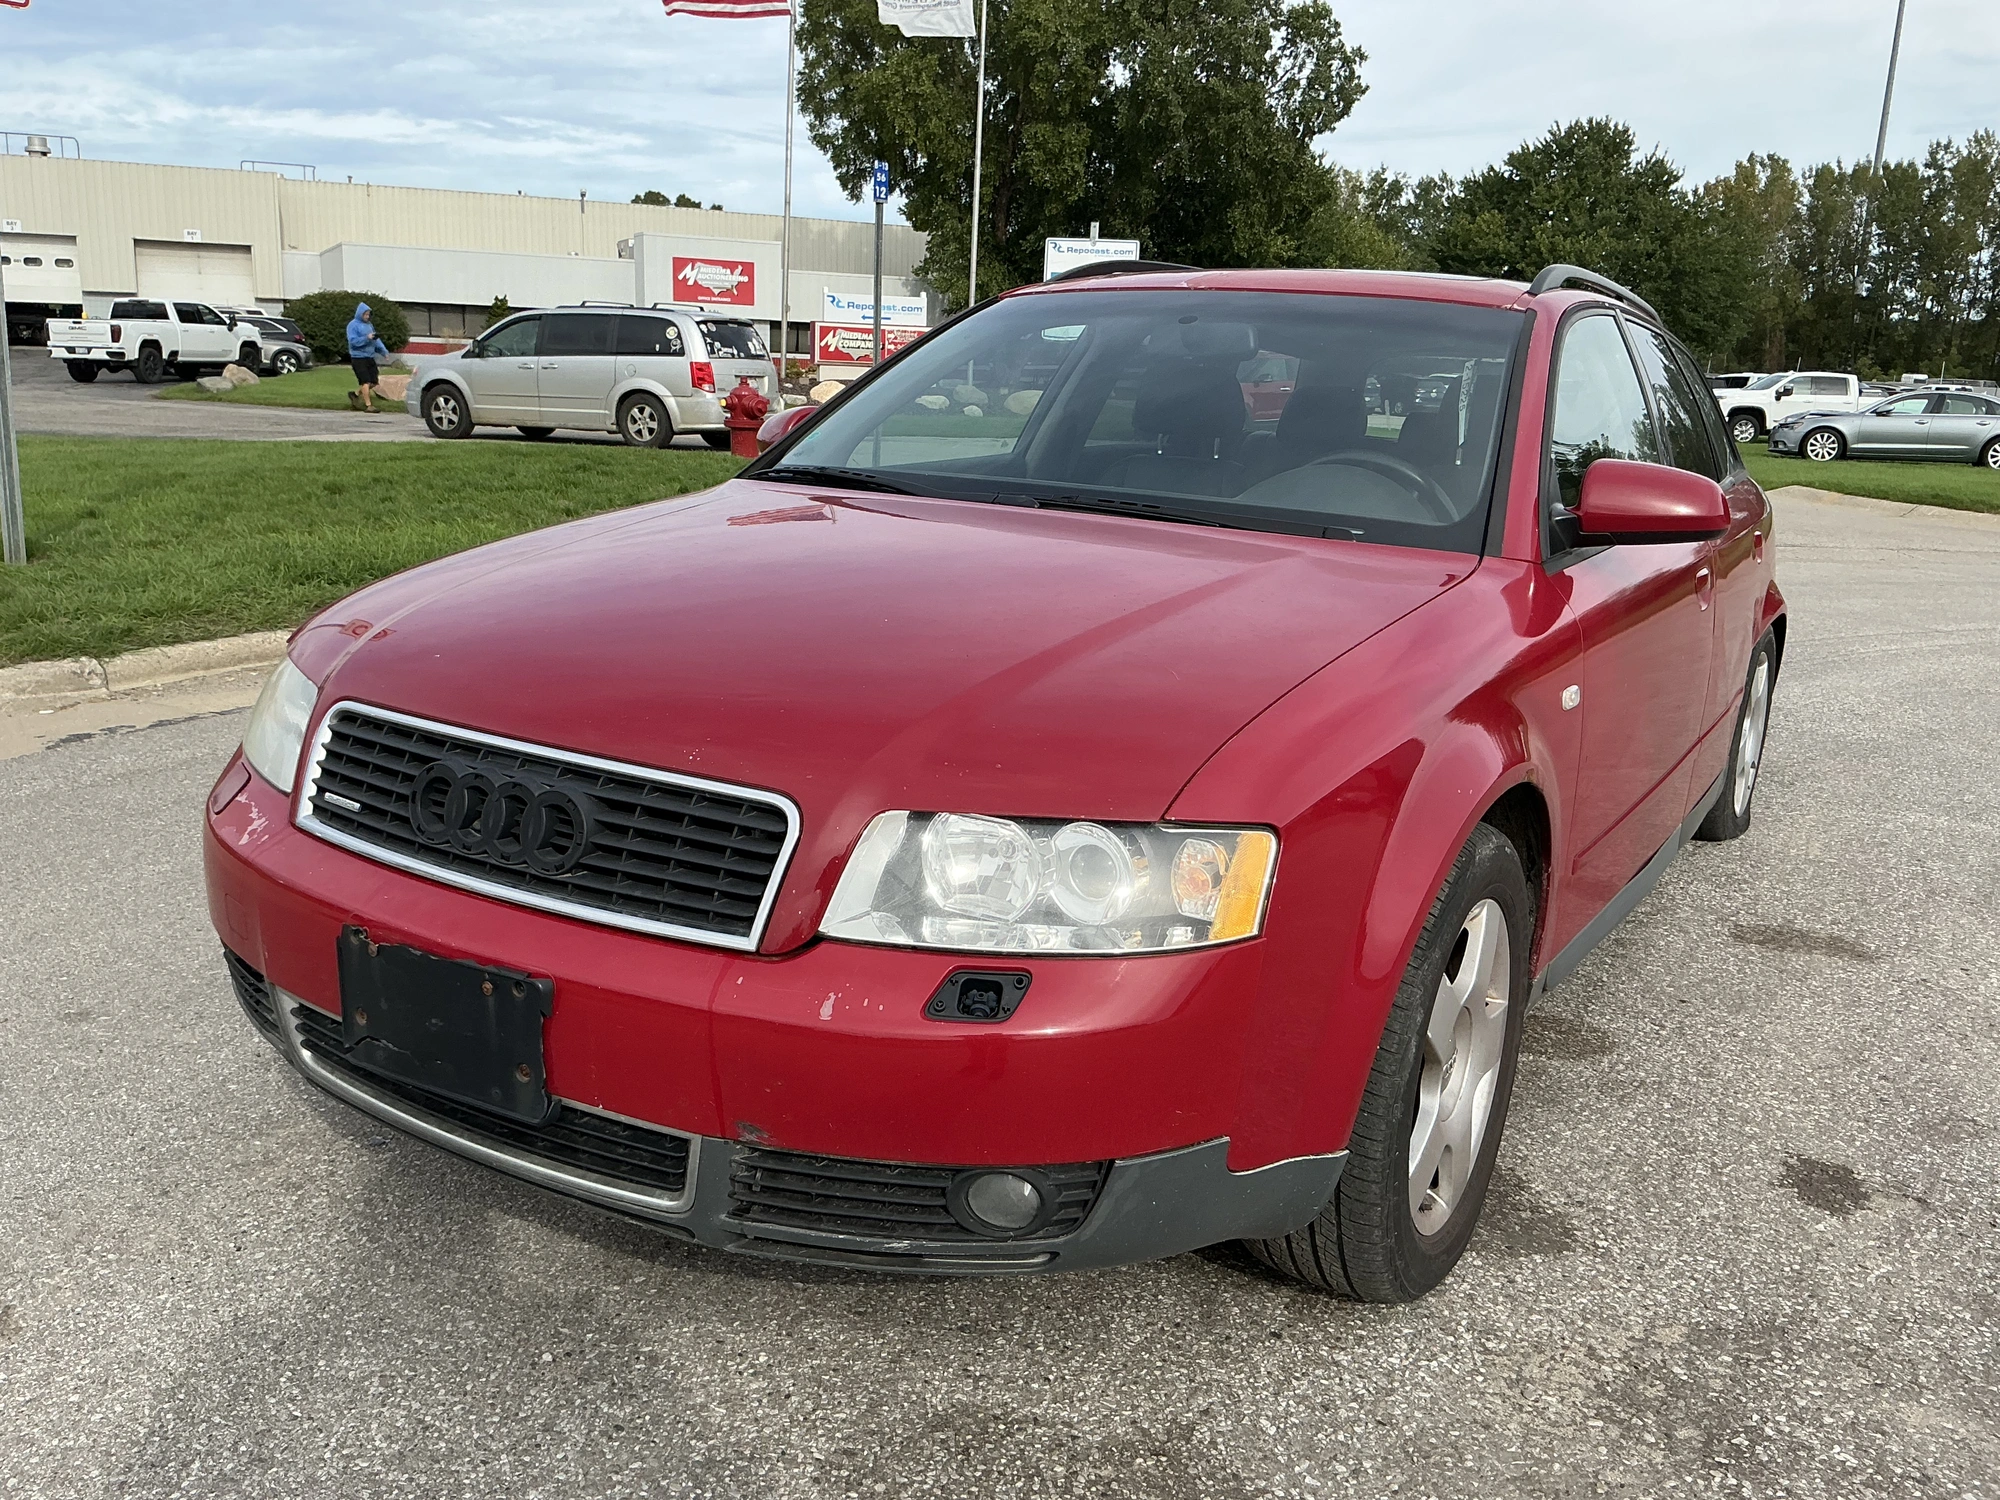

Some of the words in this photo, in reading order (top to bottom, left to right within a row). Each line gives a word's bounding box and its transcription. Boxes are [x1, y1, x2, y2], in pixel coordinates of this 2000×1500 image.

[876, 172, 886, 182] 56
[875, 185, 886, 198] 12
[1066, 246, 1134, 256] Repocast.com
[700, 267, 731, 275] MIEDEMA
[698, 274, 749, 283] AUCTIONEERING
[847, 301, 923, 313] Repoast.com
[840, 331, 874, 340] MIEDEMA
